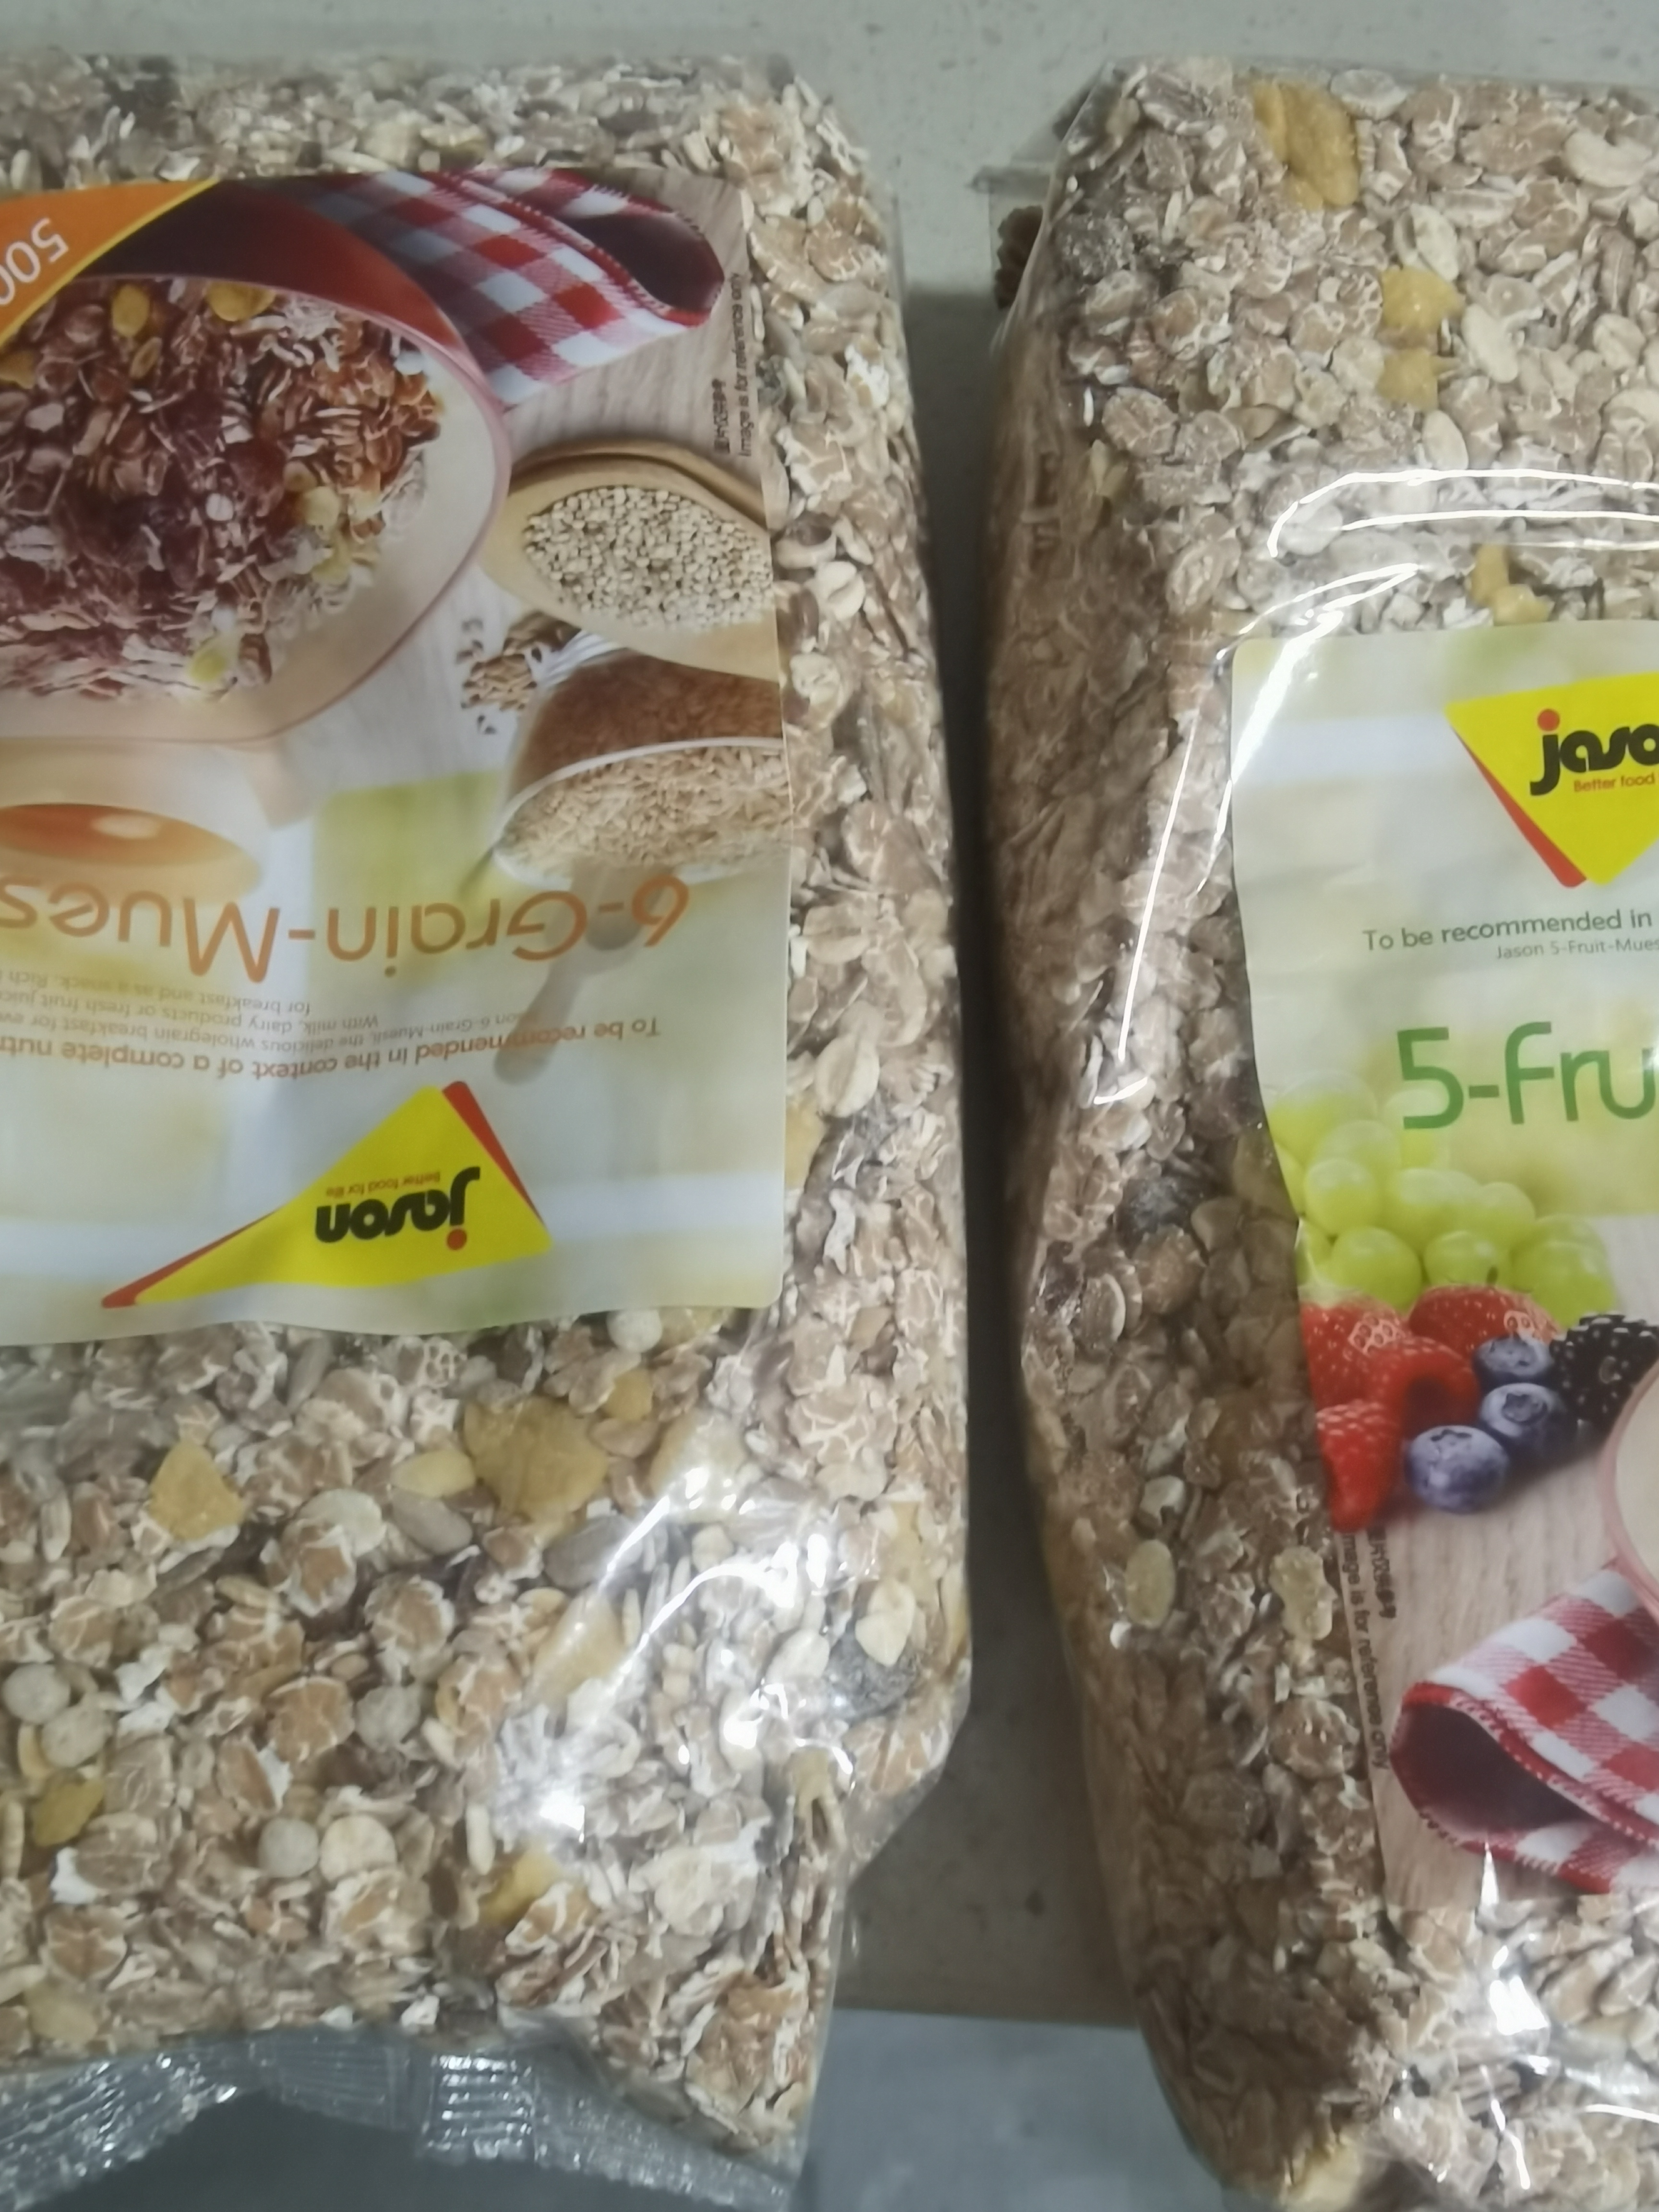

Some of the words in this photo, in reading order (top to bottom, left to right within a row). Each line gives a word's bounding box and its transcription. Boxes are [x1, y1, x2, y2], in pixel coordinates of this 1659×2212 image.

[732, 303, 747, 369] reference
[734, 371, 748, 391] for
[739, 395, 749, 407] is
[1530, 709, 1659, 796] jaso
[1574, 779, 1616, 793] Better
[1621, 772, 1656, 787] food
[0, 874, 690, 984] 6-Grain-Mues
[1362, 929, 1394, 952] To
[1401, 927, 1433, 949] be
[1441, 909, 1622, 944] recommended
[1630, 909, 1652, 928] in
[1496, 944, 1544, 959] Jason
[9, 971, 47, 988] Rich
[0, 989, 37, 1006] juic
[41, 995, 79, 1013] fruit
[199, 992, 281, 1016] breakfast
[85, 999, 130, 1018] fresh
[138, 1006, 156, 1017] or
[288, 1001, 310, 1016] for
[31, 1015, 57, 1031] for
[62, 1017, 148, 1039] breakfast
[161, 1008, 242, 1029] products
[248, 1016, 293, 1035] dairy
[342, 1015, 379, 1030] With
[631, 1017, 659, 1037] To
[155, 1027, 255, 1049] wholegrain
[594, 1022, 623, 1040] be
[261, 1038, 334, 1054] delicious
[339, 1035, 364, 1048] the
[415, 1026, 586, 1065] recommended
[61, 1042, 184, 1068] complete
[193, 1055, 210, 1071] a
[345, 1052, 380, 1071] the
[388, 1048, 408, 1065] in
[216, 1057, 243, 1079] of
[252, 1058, 337, 1080] context
[1396, 1021, 1656, 1130] 5-fru
[368, 1178, 398, 1192] food
[403, 1171, 441, 1186] Better
[348, 1183, 364, 1196] for
[315, 1166, 481, 1250] jason
[1342, 1534, 1360, 1585] mage
[1350, 1590, 1365, 1606] is
[1354, 1610, 1370, 1634] for
[1358, 1638, 1383, 1726] reference
[1370, 1731, 1390, 1769] only
